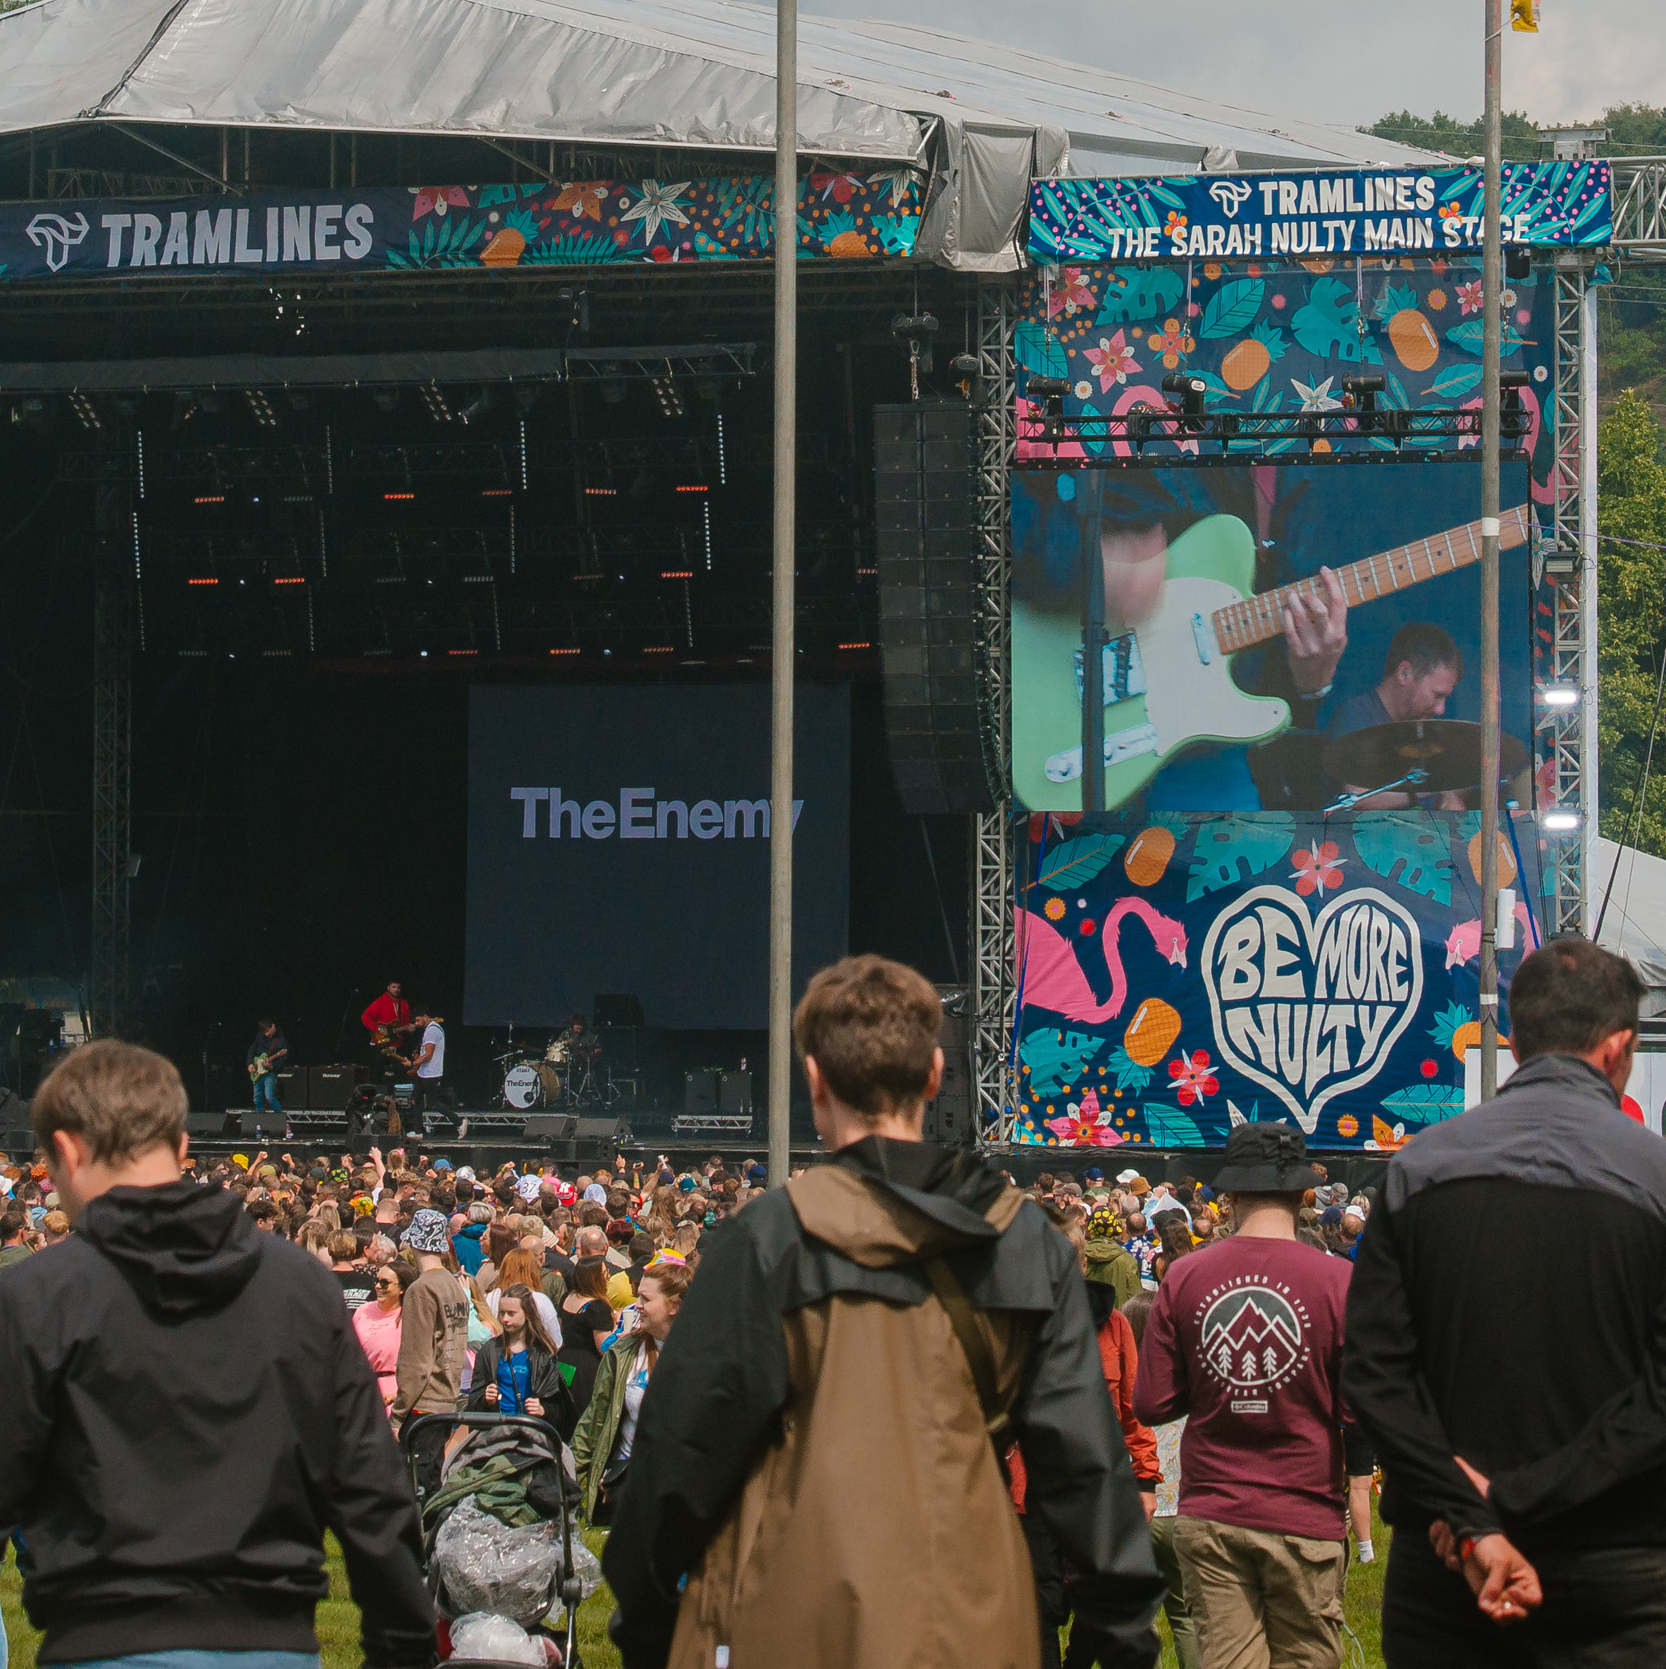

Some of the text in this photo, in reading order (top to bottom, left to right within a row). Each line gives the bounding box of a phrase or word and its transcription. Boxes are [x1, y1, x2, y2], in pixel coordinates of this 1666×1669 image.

[1259, 176, 1434, 215] TRAMLINES
[102, 203, 374, 268] TRAMLINES
[1108, 228, 1160, 259] THE
[1171, 223, 1262, 258] SARAH
[1271, 220, 1356, 253] NULTY
[1365, 218, 1433, 250] MAIN
[1217, 904, 1408, 1001] BE MORE
[1225, 1003, 1397, 1100] NULTY
[522, 1181, 536, 1195] 37
[1194, 1274, 1269, 1325] ESTABLISHED
[1276, 1281, 1290, 1295] IN
[1195, 1345, 1311, 1397] SPORTSWEAR COMPANY
